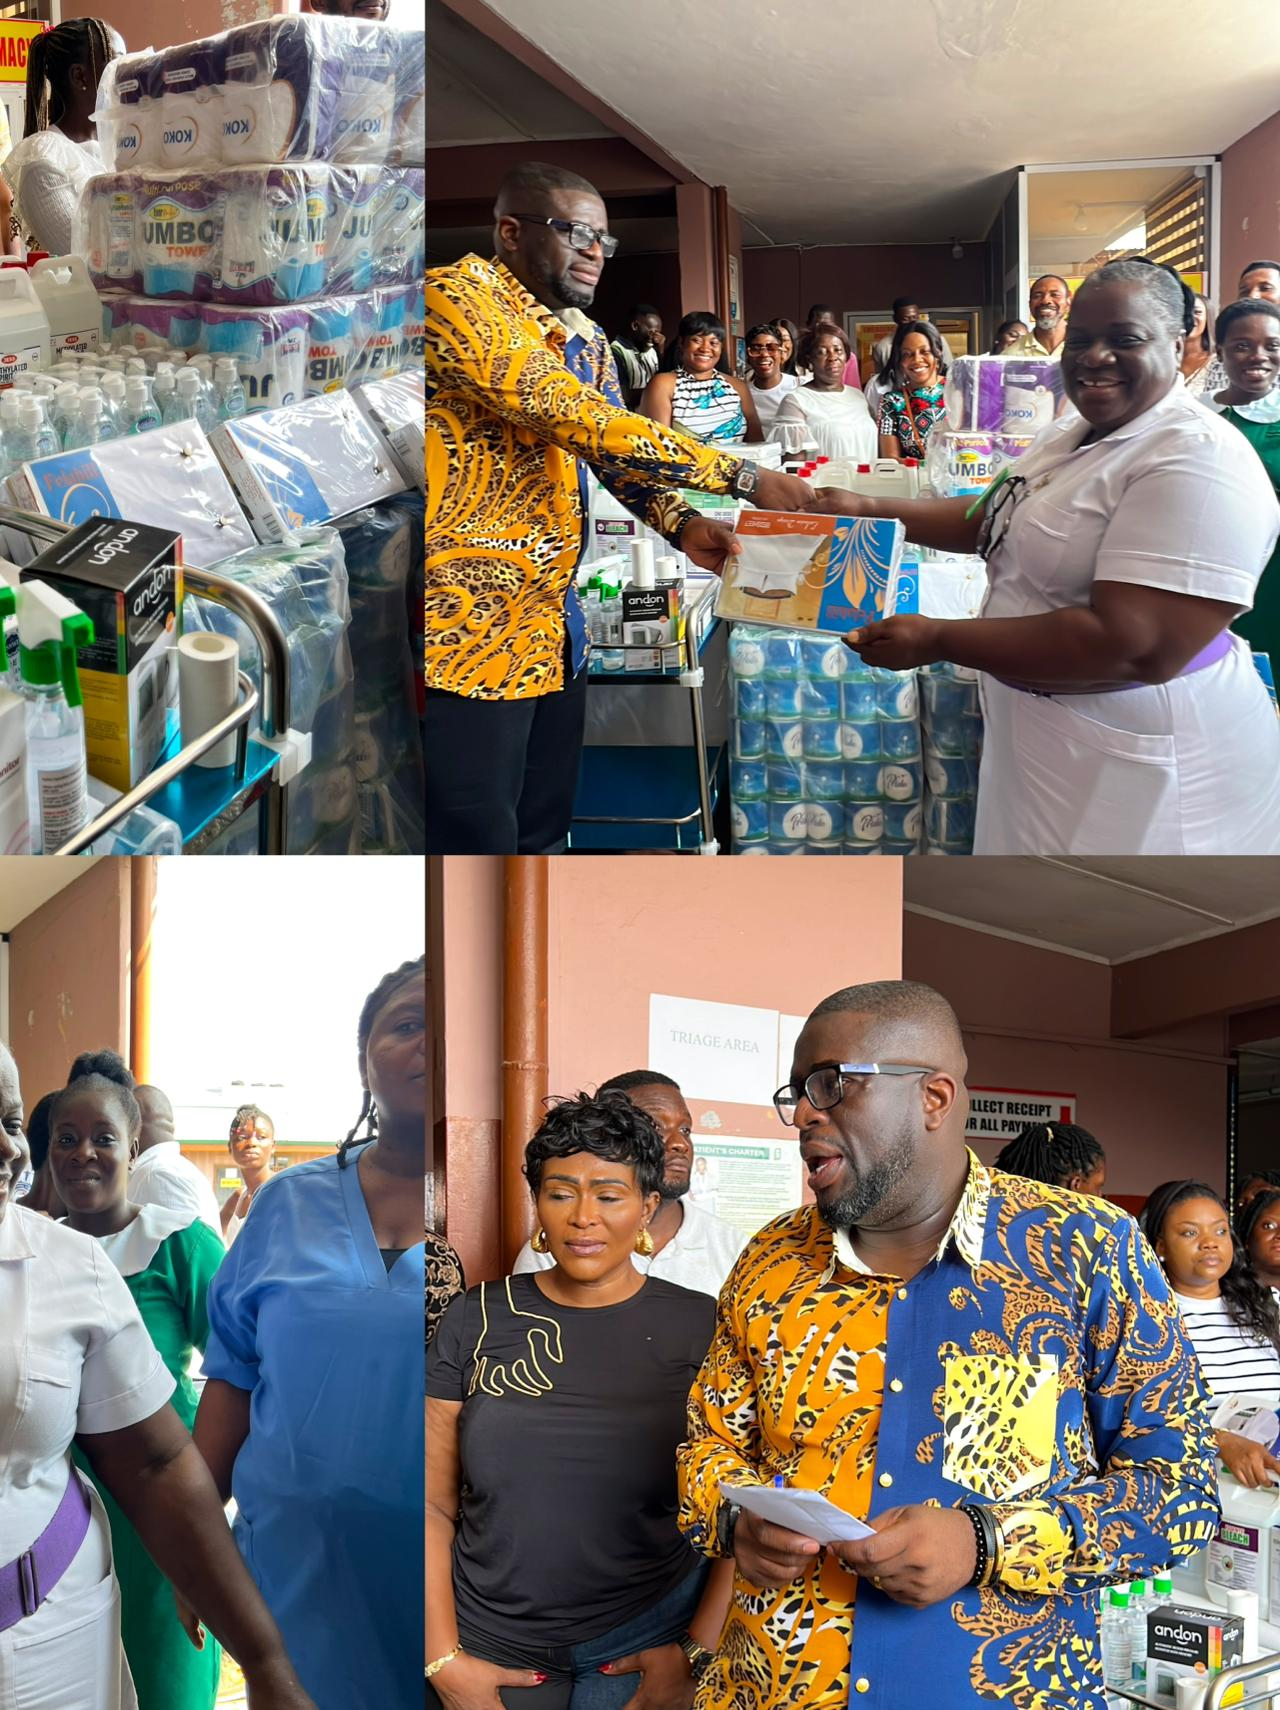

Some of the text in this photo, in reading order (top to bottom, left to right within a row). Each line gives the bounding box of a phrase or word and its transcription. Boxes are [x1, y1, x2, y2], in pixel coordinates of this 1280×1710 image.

[88, 527, 140, 567] andon
[133, 563, 171, 616] andon
[628, 593, 665, 607] andon
[670, 1029, 760, 1053] TRIAGE AREA
[969, 1099, 1052, 1117] LLECT RECEIPT
[980, 1118, 999, 1132] ALL
[728, 1147, 766, 1158] CHARTER
[1222, 1529, 1249, 1544] BLEACH
[1154, 1623, 1239, 1646] andon andon
